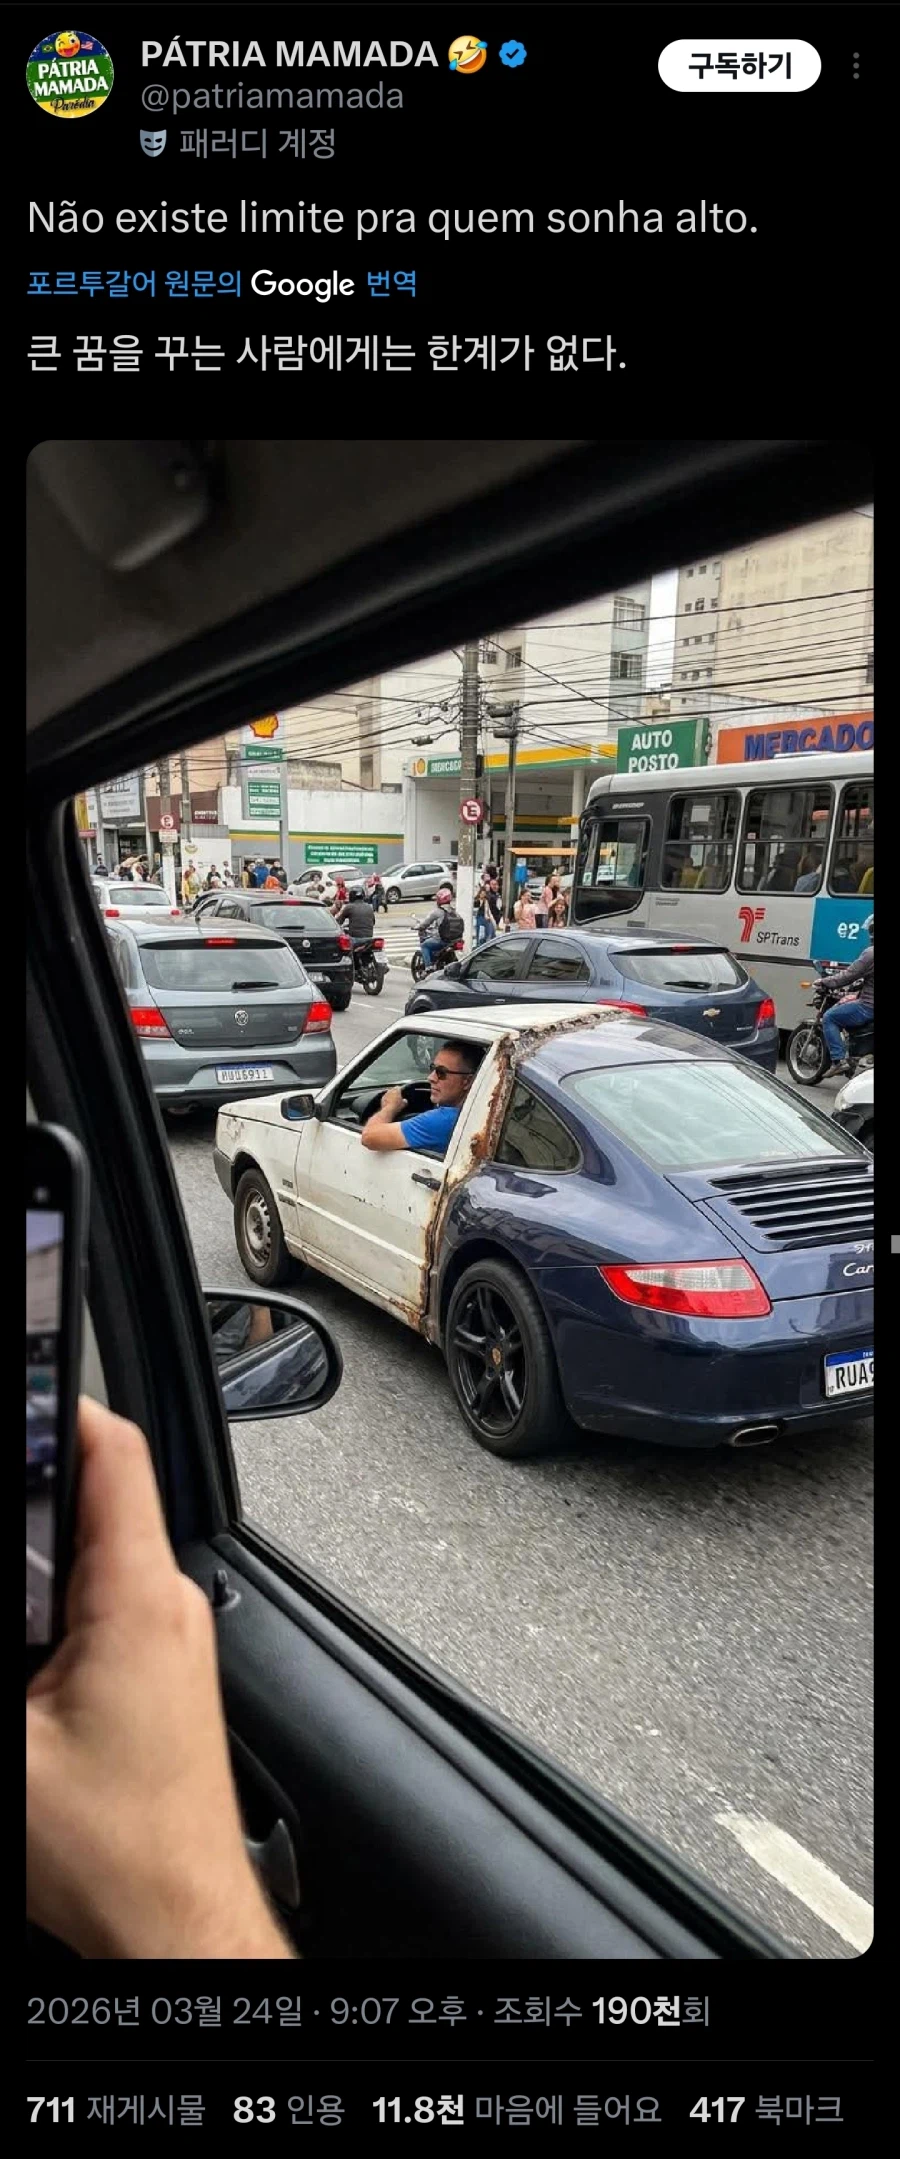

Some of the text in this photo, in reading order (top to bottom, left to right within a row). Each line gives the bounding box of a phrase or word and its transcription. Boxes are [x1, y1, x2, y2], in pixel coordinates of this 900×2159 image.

[631, 729, 673, 751] AUTO
[628, 753, 680, 774] POSTO
[756, 931, 800, 947] SPTrans
